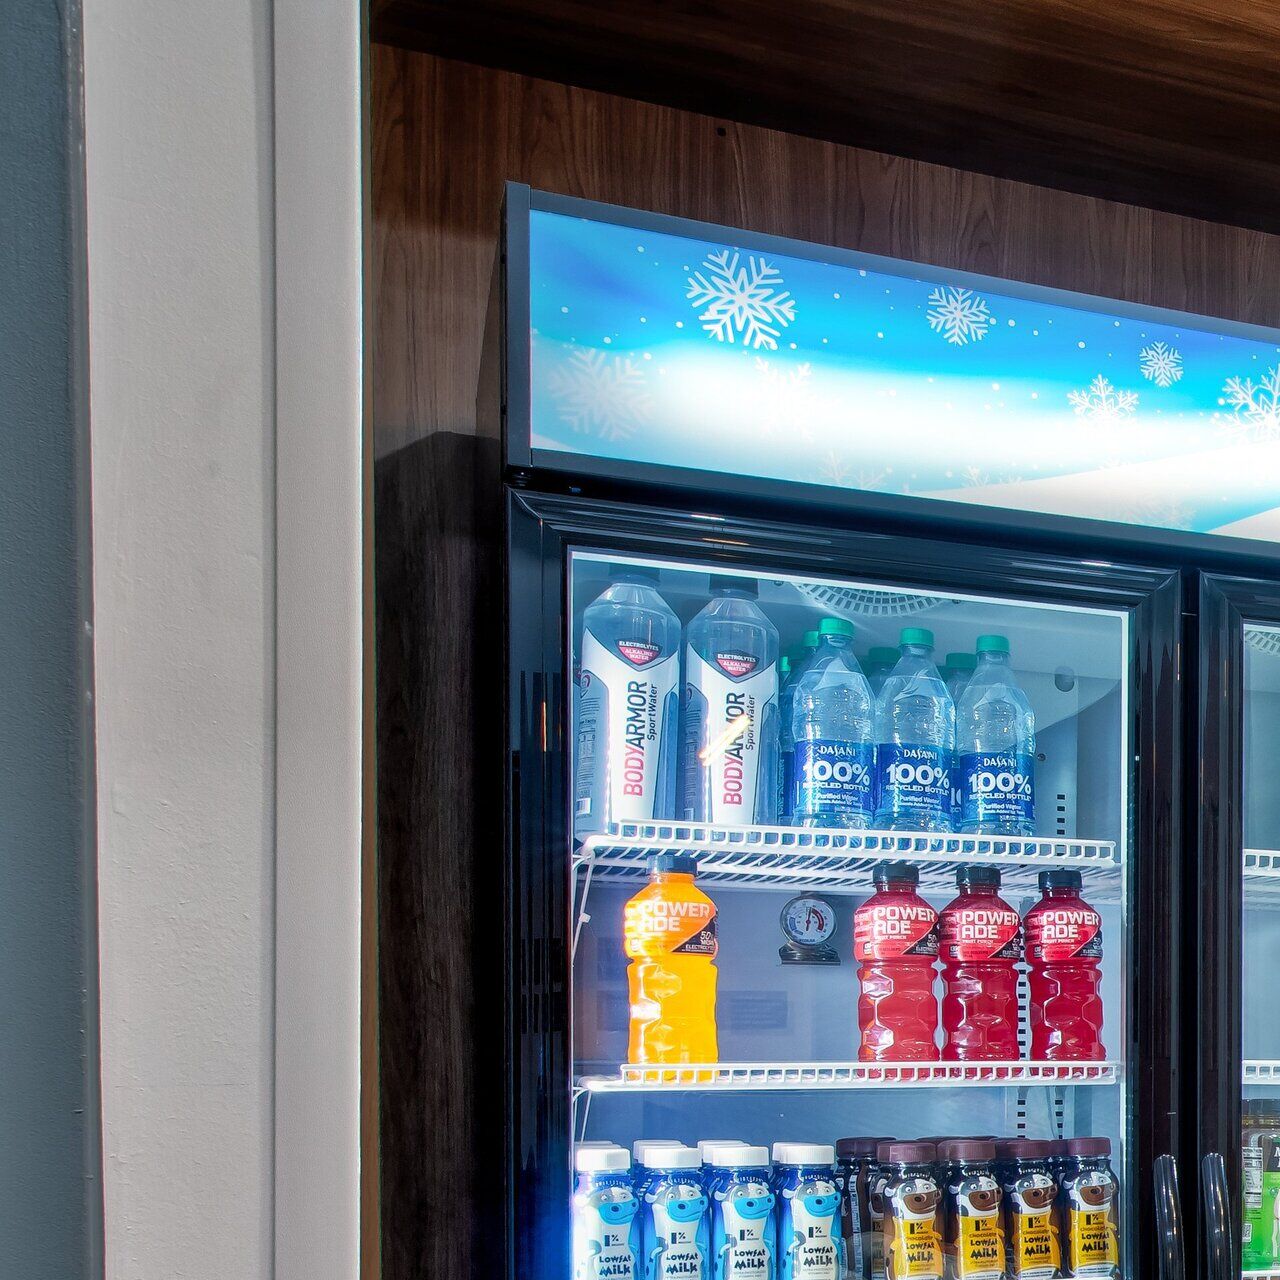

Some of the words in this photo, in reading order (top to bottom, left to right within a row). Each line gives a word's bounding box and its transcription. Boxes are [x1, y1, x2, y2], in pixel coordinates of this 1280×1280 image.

[623, 680, 648, 797] BODYARMOR
[819, 745, 856, 757] DASANI
[903, 749, 938, 760] DASANI
[983, 757, 1017, 768] DASANI
[803, 761, 871, 785] 100%
[886, 763, 950, 789] 100%
[969, 772, 1032, 795] 100%
[873, 906, 936, 923] POWER
[962, 911, 1020, 926] POWER
[1043, 911, 1100, 926] POWER
[873, 920, 912, 935] ADE
[962, 924, 1001, 939] ADE
[1043, 924, 1080, 939] ADE
